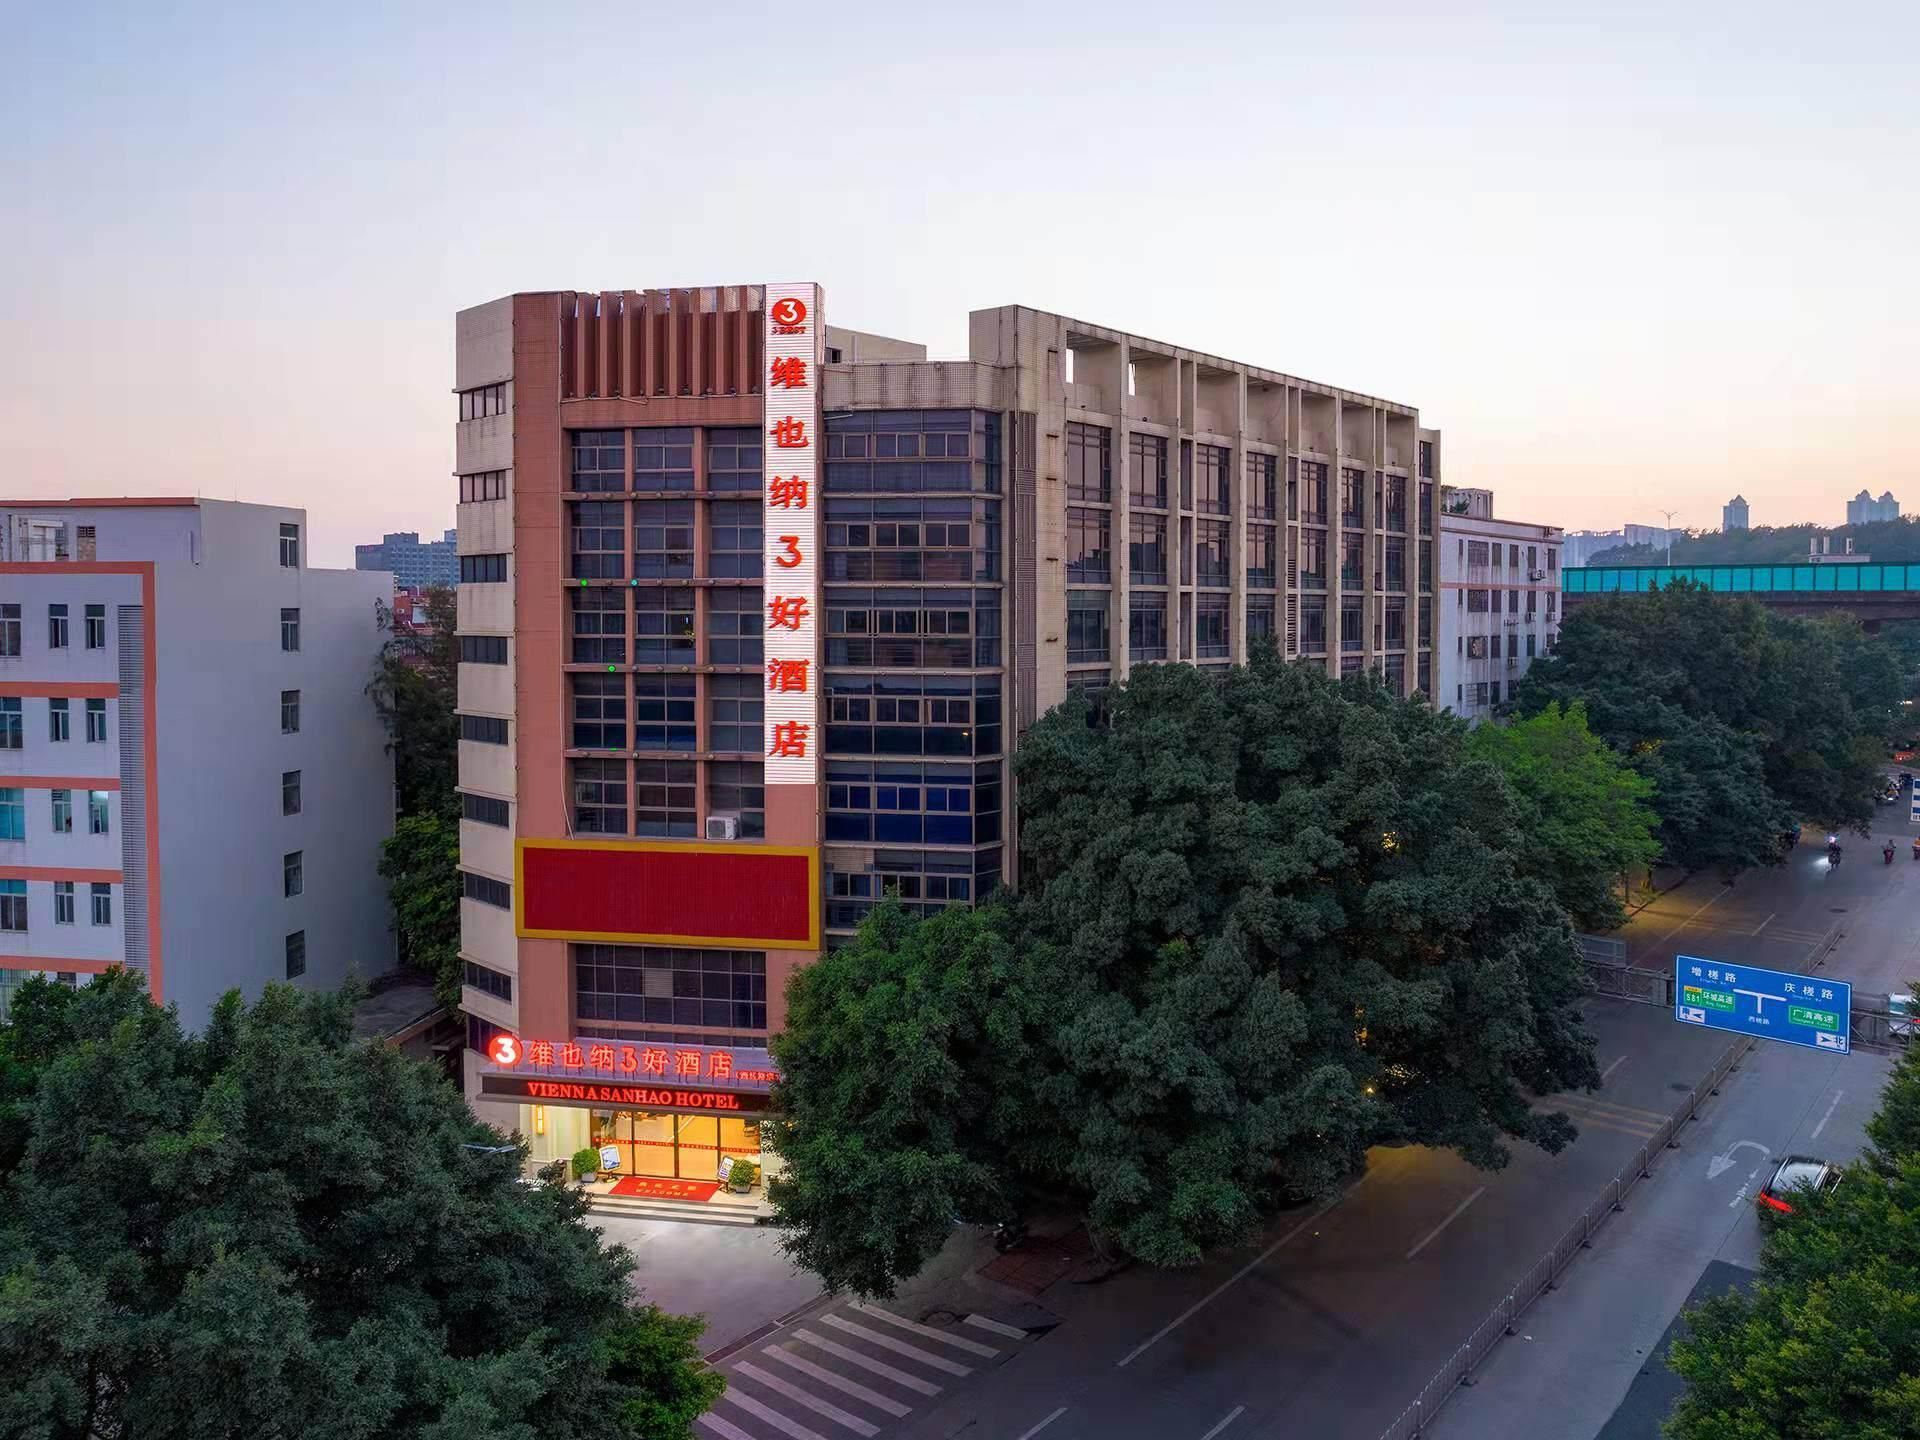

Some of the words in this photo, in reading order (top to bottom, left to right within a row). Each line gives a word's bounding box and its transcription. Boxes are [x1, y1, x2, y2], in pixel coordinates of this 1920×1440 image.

[779, 301, 798, 322] 3
[769, 356, 809, 757] 维也纳3好酒店
[1691, 966, 1736, 983] 增槎路
[1686, 993, 1700, 1003] S81
[1702, 991, 1733, 1005] 环城高速
[1784, 983, 1833, 1000] 庆槎路
[1793, 1009, 1834, 1024] 广清高速
[495, 1037, 516, 1064] 3
[528, 1040, 734, 1079] 维也纳3好酒店
[527, 1082, 598, 1100] VIENNA
[600, 1086, 672, 1105] SANHAO
[674, 1091, 739, 1110] HOTEL
